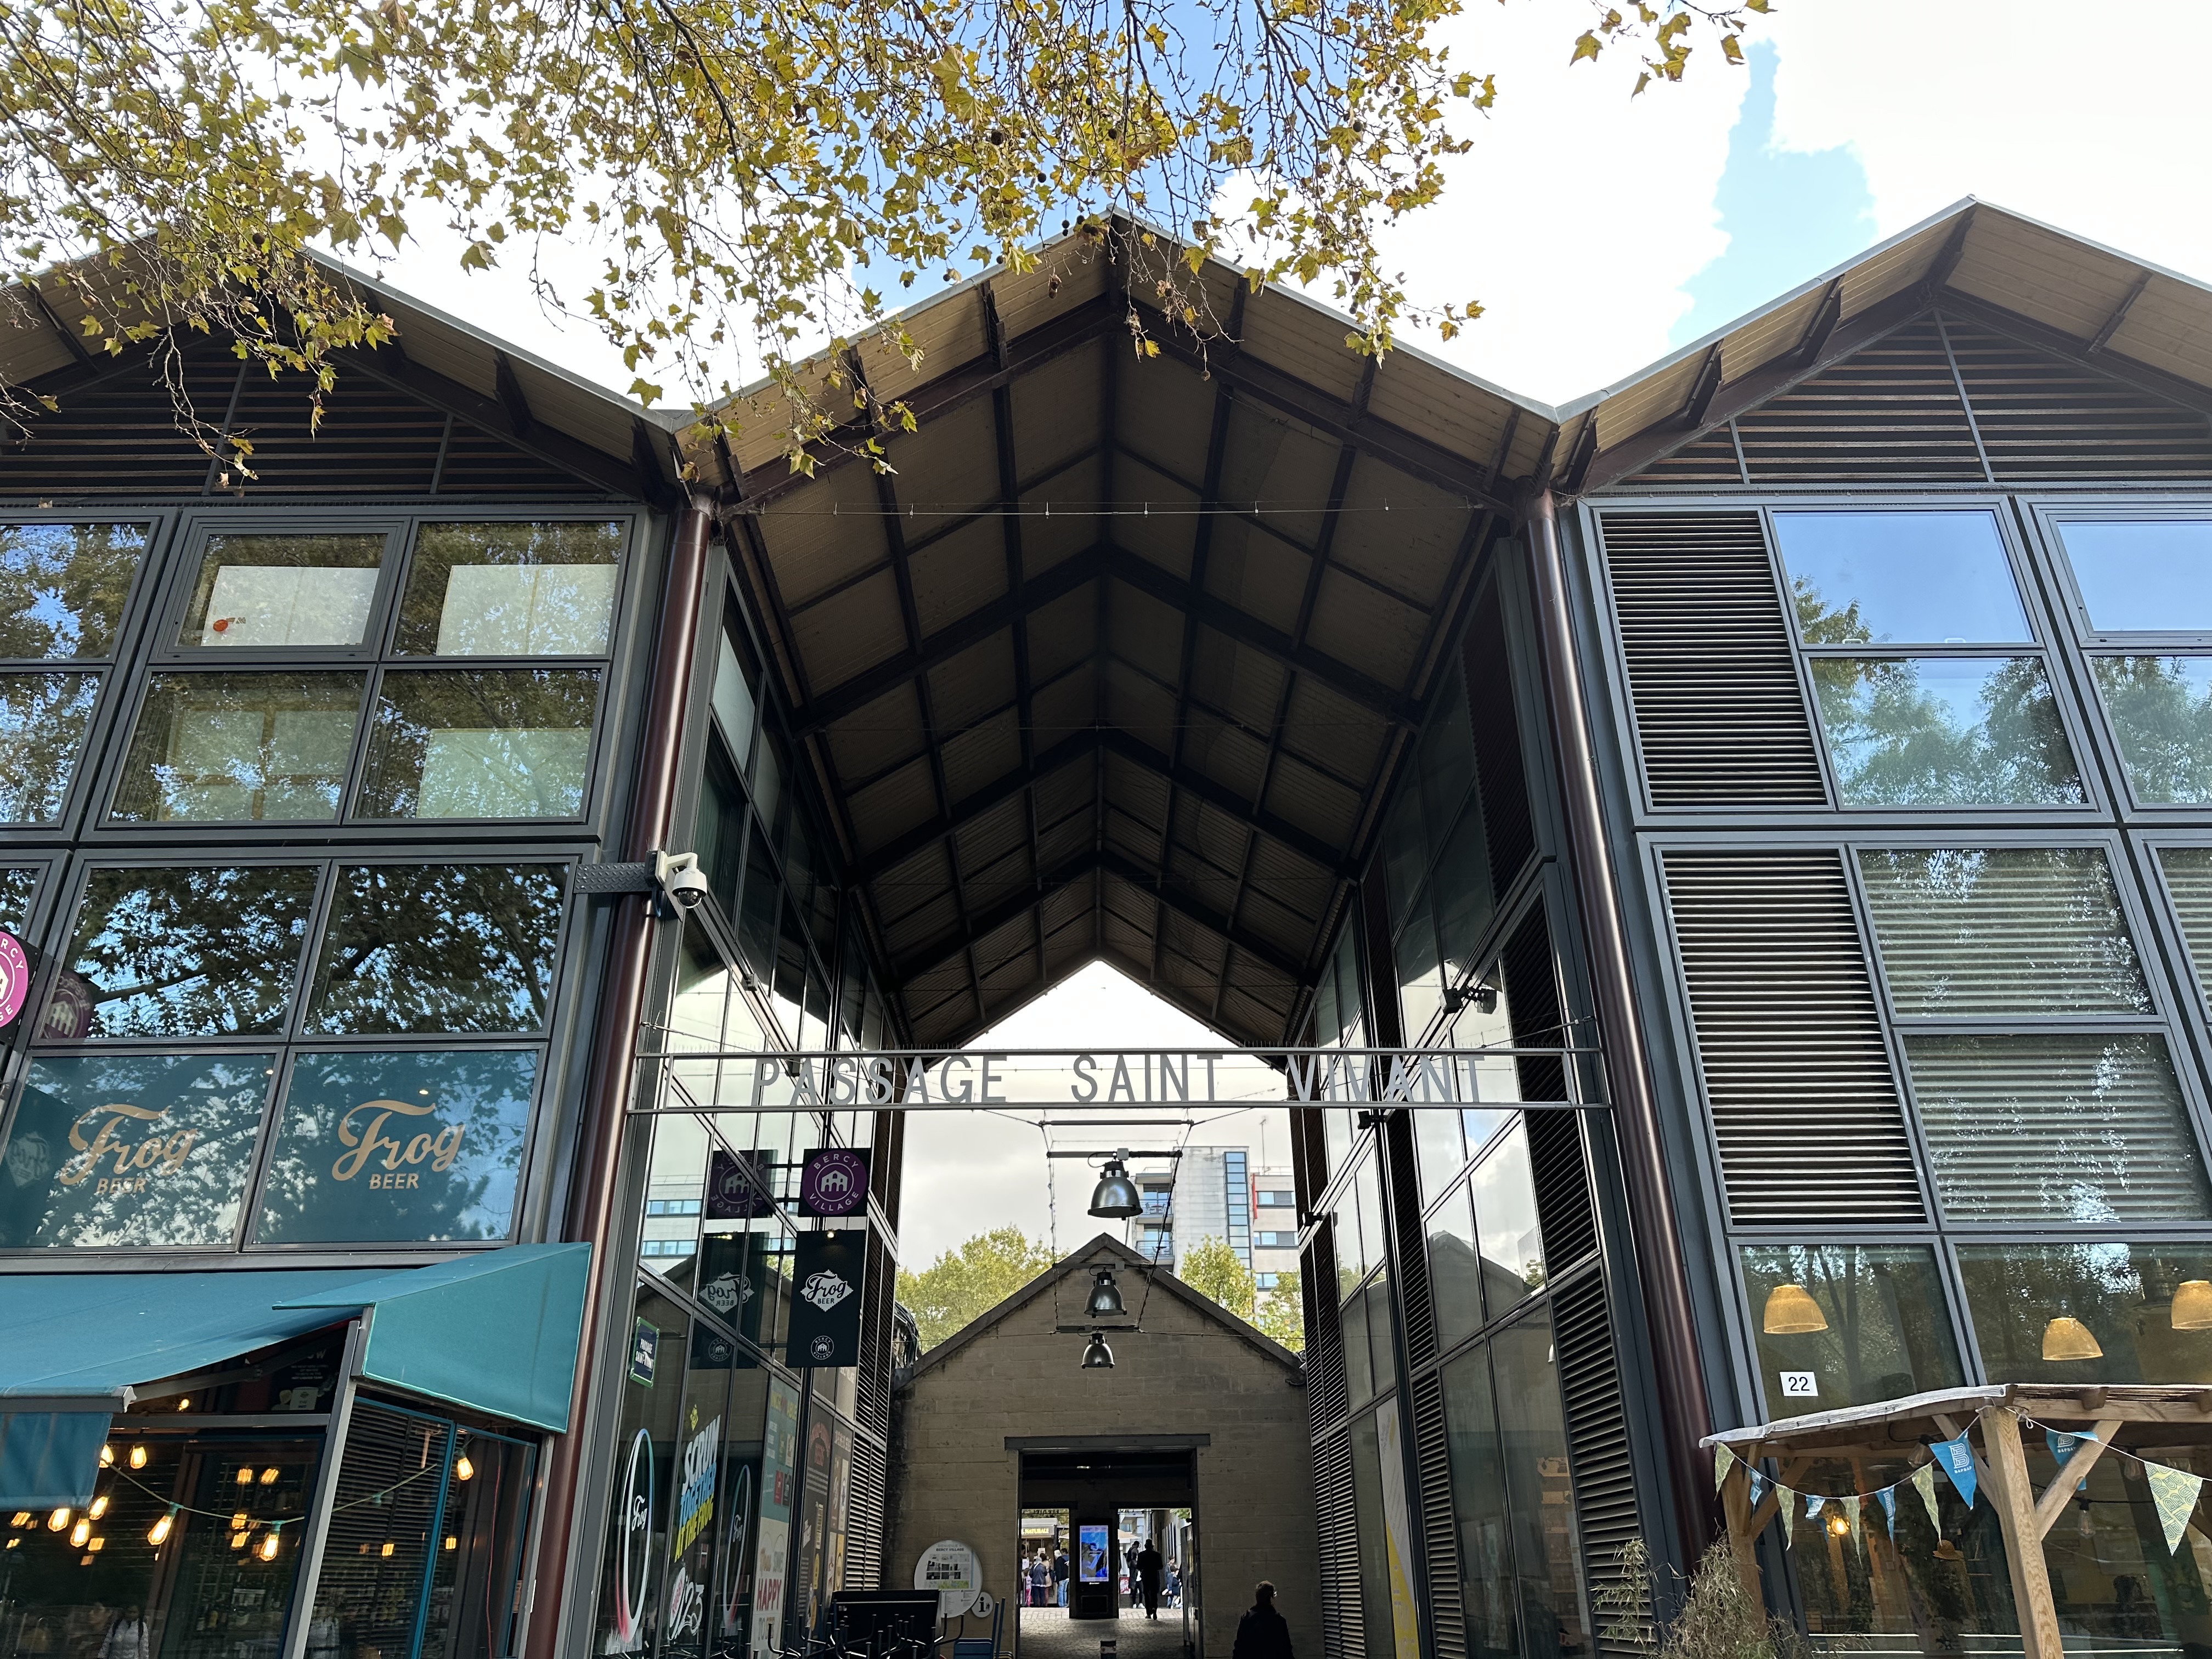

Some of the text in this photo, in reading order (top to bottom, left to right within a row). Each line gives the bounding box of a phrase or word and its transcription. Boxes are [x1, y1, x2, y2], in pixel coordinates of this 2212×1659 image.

[0, 938, 24, 969] RCY
[751, 1053, 1485, 1105] PASSAGE SAINT VIVANT
[59, 1104, 198, 1186] Frog
[331, 1099, 466, 1181] Frog
[813, 1153, 859, 1170] BERCY
[96, 1177, 147, 1194] BEER
[369, 1173, 419, 1189] BEER
[809, 1191, 859, 1211] VILLAGE
[806, 1273, 847, 1301] Frog
[1788, 1376, 1810, 1391] 22
[681, 1414, 721, 1496] SCRUM
[631, 1494, 648, 1531] Frog
[679, 1461, 717, 1531] TOGETHER
[674, 1526, 686, 1563] AT
[685, 1510, 698, 1550] THE
[696, 1492, 714, 1536] FROG
[757, 1578, 782, 1612] HAPPY
